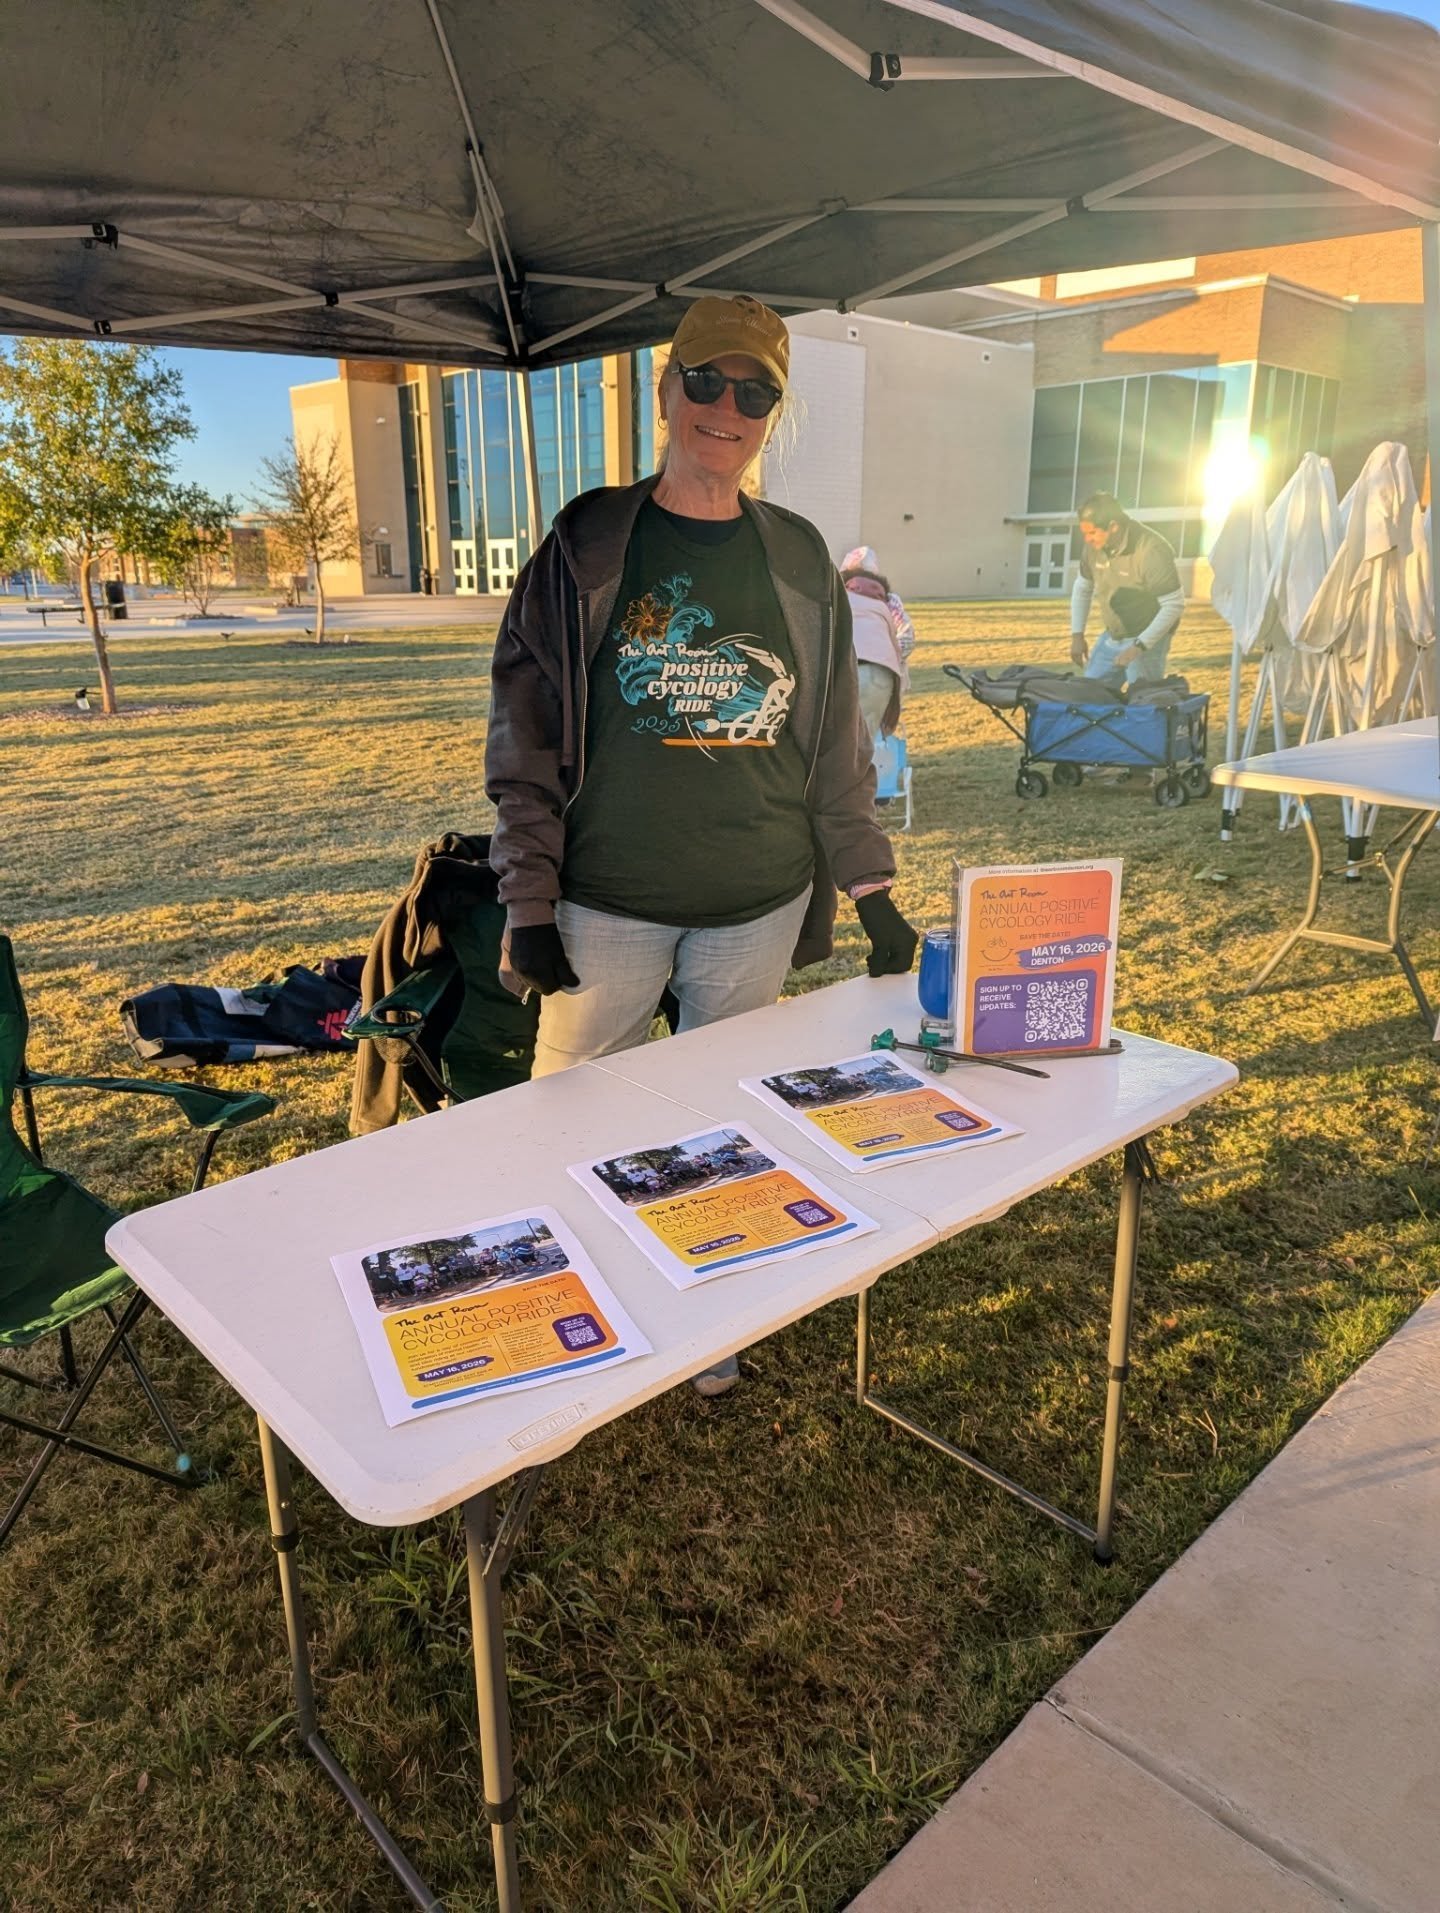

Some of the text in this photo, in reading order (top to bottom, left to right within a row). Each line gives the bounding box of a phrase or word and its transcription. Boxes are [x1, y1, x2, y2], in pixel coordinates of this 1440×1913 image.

[618, 643, 718, 657] The Art Room
[660, 659, 749, 680] positive
[647, 677, 744, 699] cycology
[674, 699, 713, 713] RIDE
[630, 715, 684, 735] 2025
[981, 887, 1049, 900] The Art Room
[979, 898, 1100, 916] ANNUAL POSITIVE
[979, 911, 1086, 930] CYCOLOGY RIDE
[1031, 942, 1106, 957] MAY 16, 2026
[1031, 957, 1064, 966] DENTON
[979, 986, 998, 994] SIGN
[979, 993, 1011, 1002] RECEIVE
[979, 1002, 1017, 1011] UPDATES:
[656, 1203, 724, 1226] ANNUAL
[723, 1182, 792, 1207] POSITIVE
[662, 1204, 747, 1233] CYCOLOGY
[749, 1192, 789, 1209] RIDE
[692, 1244, 710, 1253] MAY
[395, 1302, 489, 1327] The Art Room
[400, 1288, 577, 1341] ANNUAL POSITIVE
[403, 1315, 511, 1351] CYCOLOGY
[516, 1303, 565, 1323] RIDE
[424, 1369, 445, 1379] MAY
[461, 1359, 487, 1370] 2026
